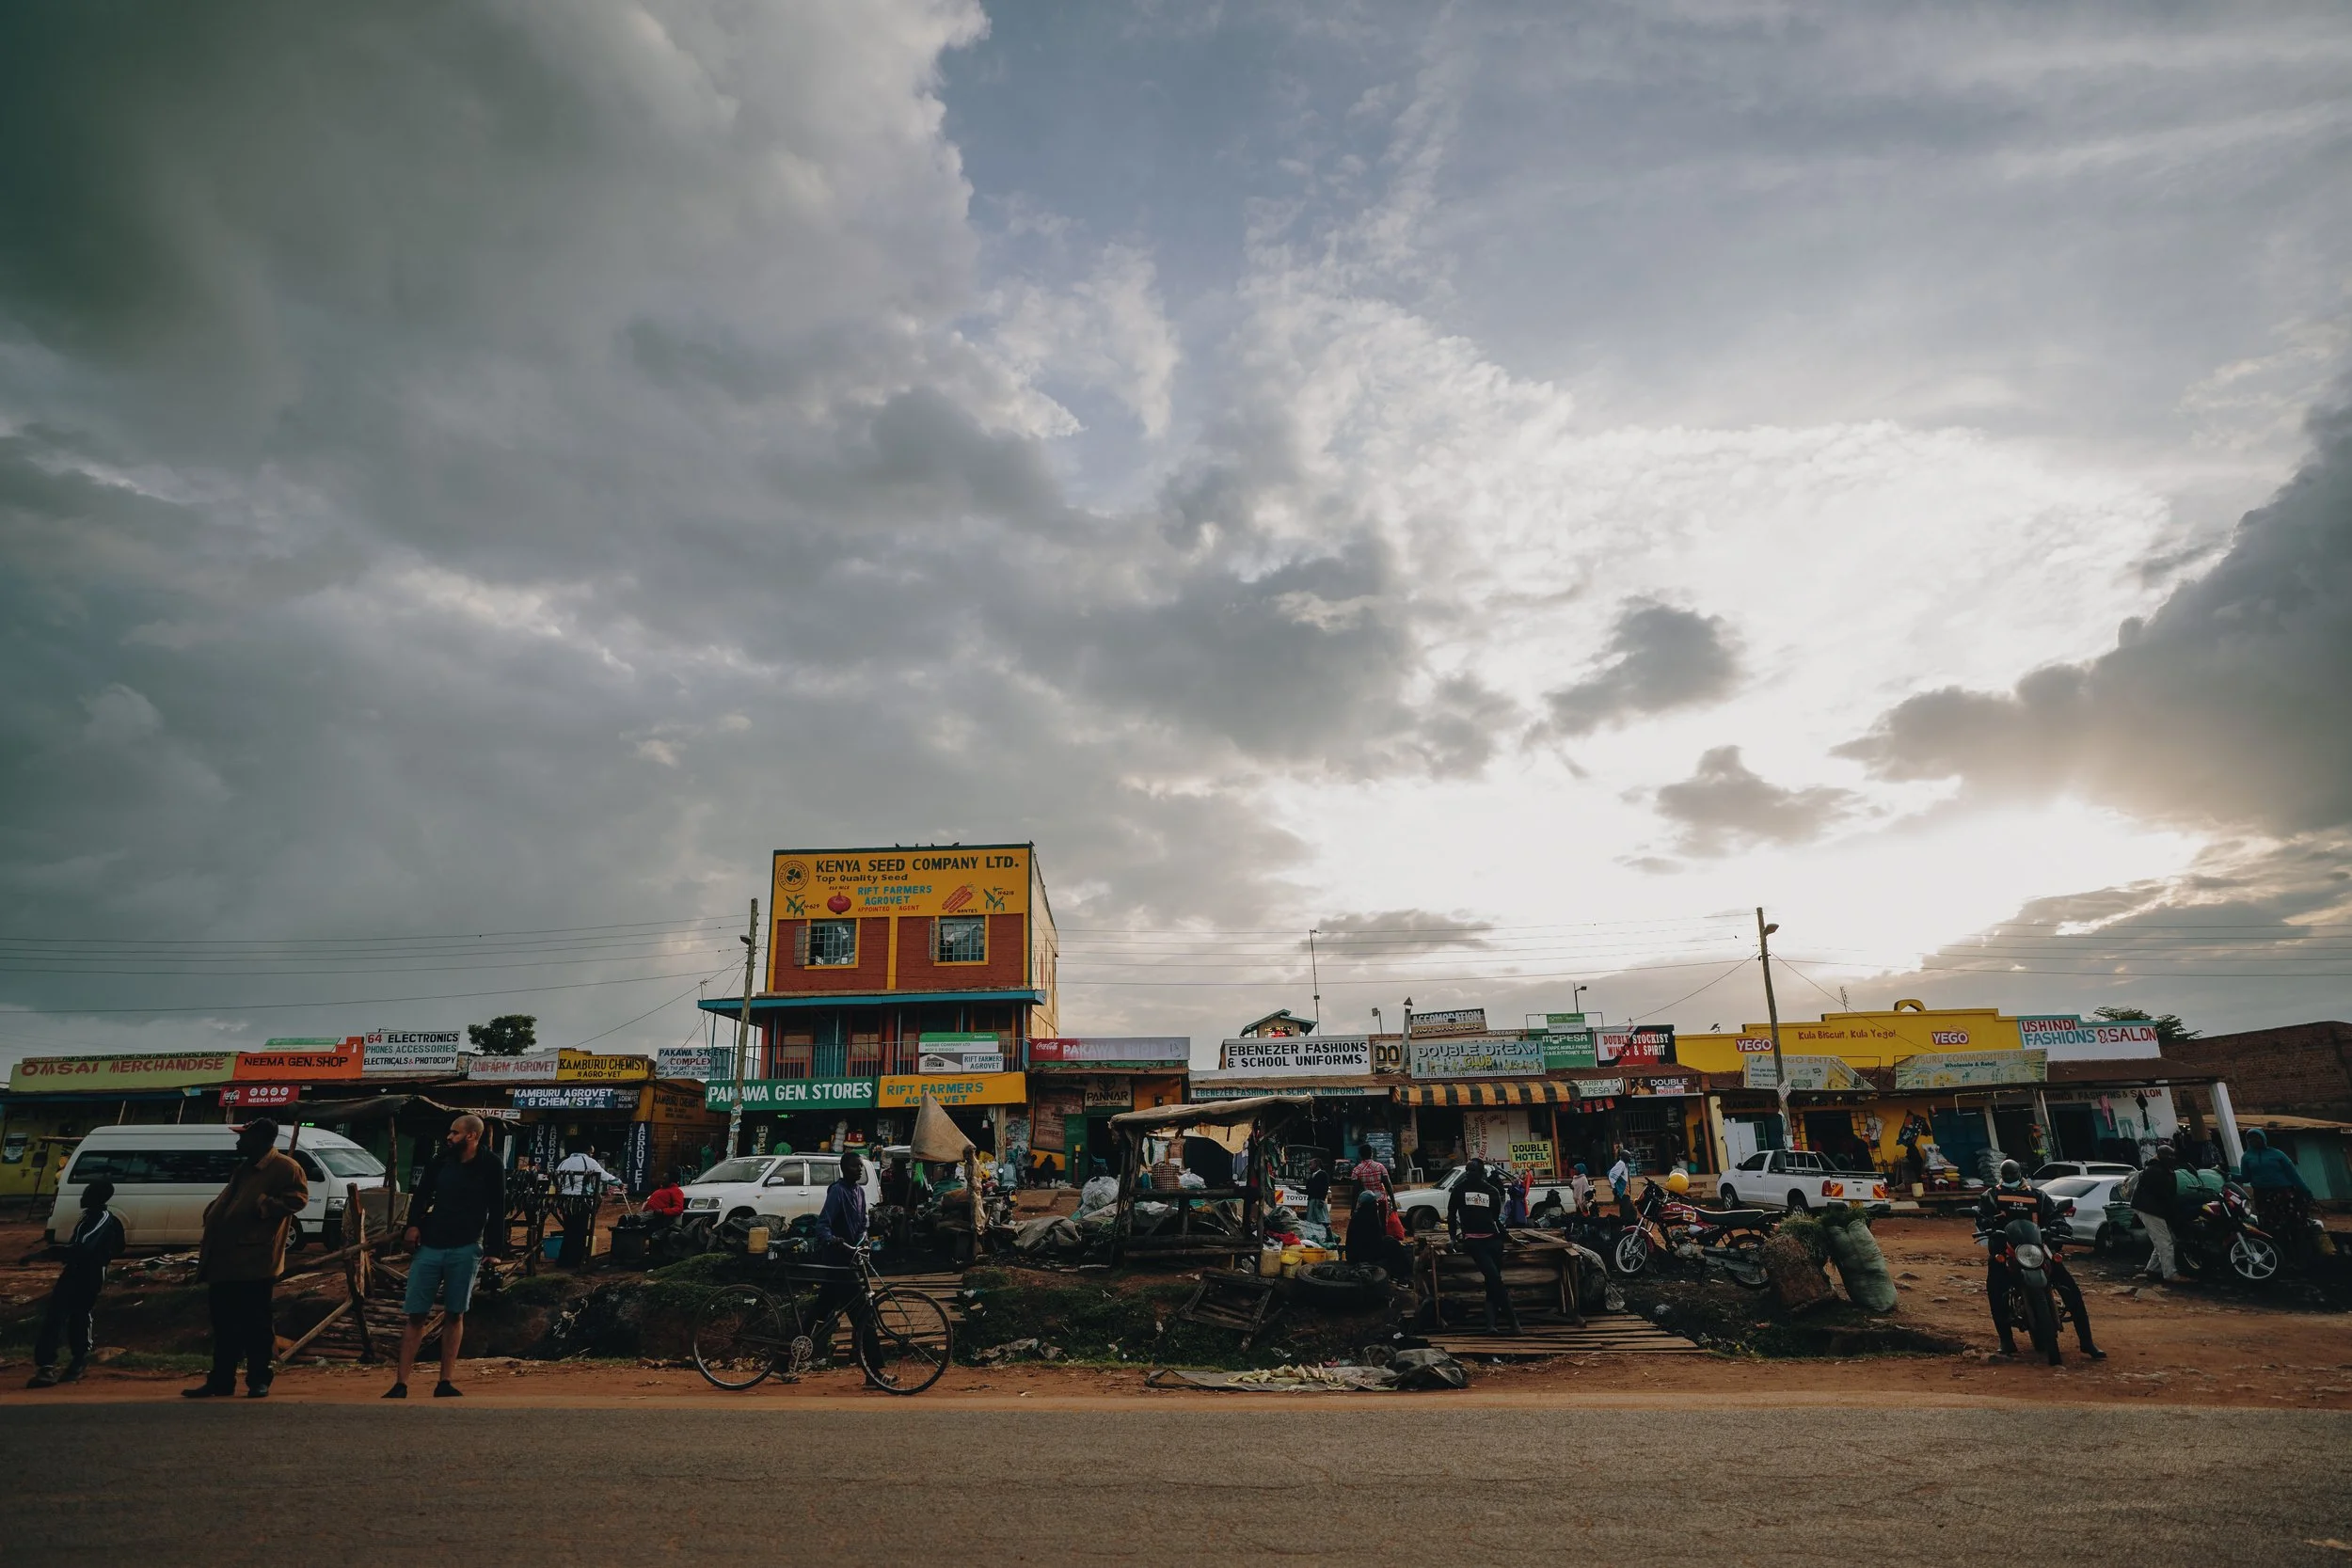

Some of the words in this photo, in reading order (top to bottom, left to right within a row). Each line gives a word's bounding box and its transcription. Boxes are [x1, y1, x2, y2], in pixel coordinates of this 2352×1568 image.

[816, 860, 861, 873] KENYA
[868, 859, 905, 872] SEED
[913, 857, 977, 871] COMPANY
[986, 856, 1019, 869] LTD.
[816, 875, 835, 884] Top
[839, 874, 878, 884] Quality
[881, 874, 908, 882] Seed
[857, 886, 879, 895] RIFT
[883, 885, 932, 895] FARMERS
[865, 895, 910, 906] AGROVET
[2022, 1021, 2076, 1033] USHINDI
[368, 1034, 382, 1043] 64
[388, 1033, 459, 1043] ELECTRONICS
[1632, 1034, 1669, 1044] STOCKIST
[1798, 1031, 1816, 1040] Kula
[1850, 1029, 1867, 1038] Kula
[1870, 1029, 1896, 1039] Yego!
[1932, 1032, 1968, 1044] YEGO
[2025, 1029, 2096, 1045] FASHIONS
[365, 1045, 393, 1053] PHONES
[395, 1044, 457, 1053] ACCESSORIES
[1036, 1041, 1058, 1051] Coca-Cola
[1063, 1044, 1118, 1055] PAKAWA
[1229, 1044, 1298, 1056] EBENEZER
[1305, 1042, 1368, 1053] FASHIONS
[1418, 1044, 1480, 1057] DOUBLE
[1484, 1043, 1539, 1056] DREAM
[1633, 1045, 1639, 1055] &
[1643, 1044, 1665, 1055] SPIRIT
[1737, 1039, 1772, 1051] YEGO
[245, 1056, 284, 1066] NEEMA
[363, 1056, 408, 1066] ELECTRICALS
[414, 1056, 456, 1065] PHOTOCOPY
[1228, 1059, 1235, 1068] &
[1241, 1056, 1290, 1067] SCHOOL
[1295, 1053, 1368, 1066] UNIFORMS.
[1463, 1054, 1492, 1068] CLUB
[1912, 1053, 1944, 1064] MBURU
[1947, 1051, 2010, 1062] COMMODITIES
[21, 1062, 100, 1076] OMSAI
[109, 1057, 226, 1073] MERCHANDISE
[513, 1060, 556, 1073] AGROVET
[558, 1058, 607, 1069] KAMBURU
[609, 1059, 645, 1071] CHEMIST
[1650, 1078, 1689, 1086] DOUBLE
[514, 1089, 561, 1098] KAMBURU
[564, 1088, 613, 1097] AGROVET
[774, 1085, 808, 1101] GEN.
[812, 1083, 872, 1100] STORES
[887, 1085, 914, 1095] RIFT
[921, 1082, 984, 1094] FARMERS
[1196, 1088, 1233, 1097] EBENEZER
[1321, 1086, 1365, 1095] UNIFORMS
[904, 1095, 967, 1104] AG-VET
[1087, 1090, 1129, 1101] PANNAR
[528, 1097, 535, 1106] &
[1512, 1143, 1549, 1152] DOUBLE
[635, 1122, 645, 1191] AGROVET
[1515, 1152, 1546, 1162] HOTEL
[1512, 1161, 1549, 1169] BUTCHERY
